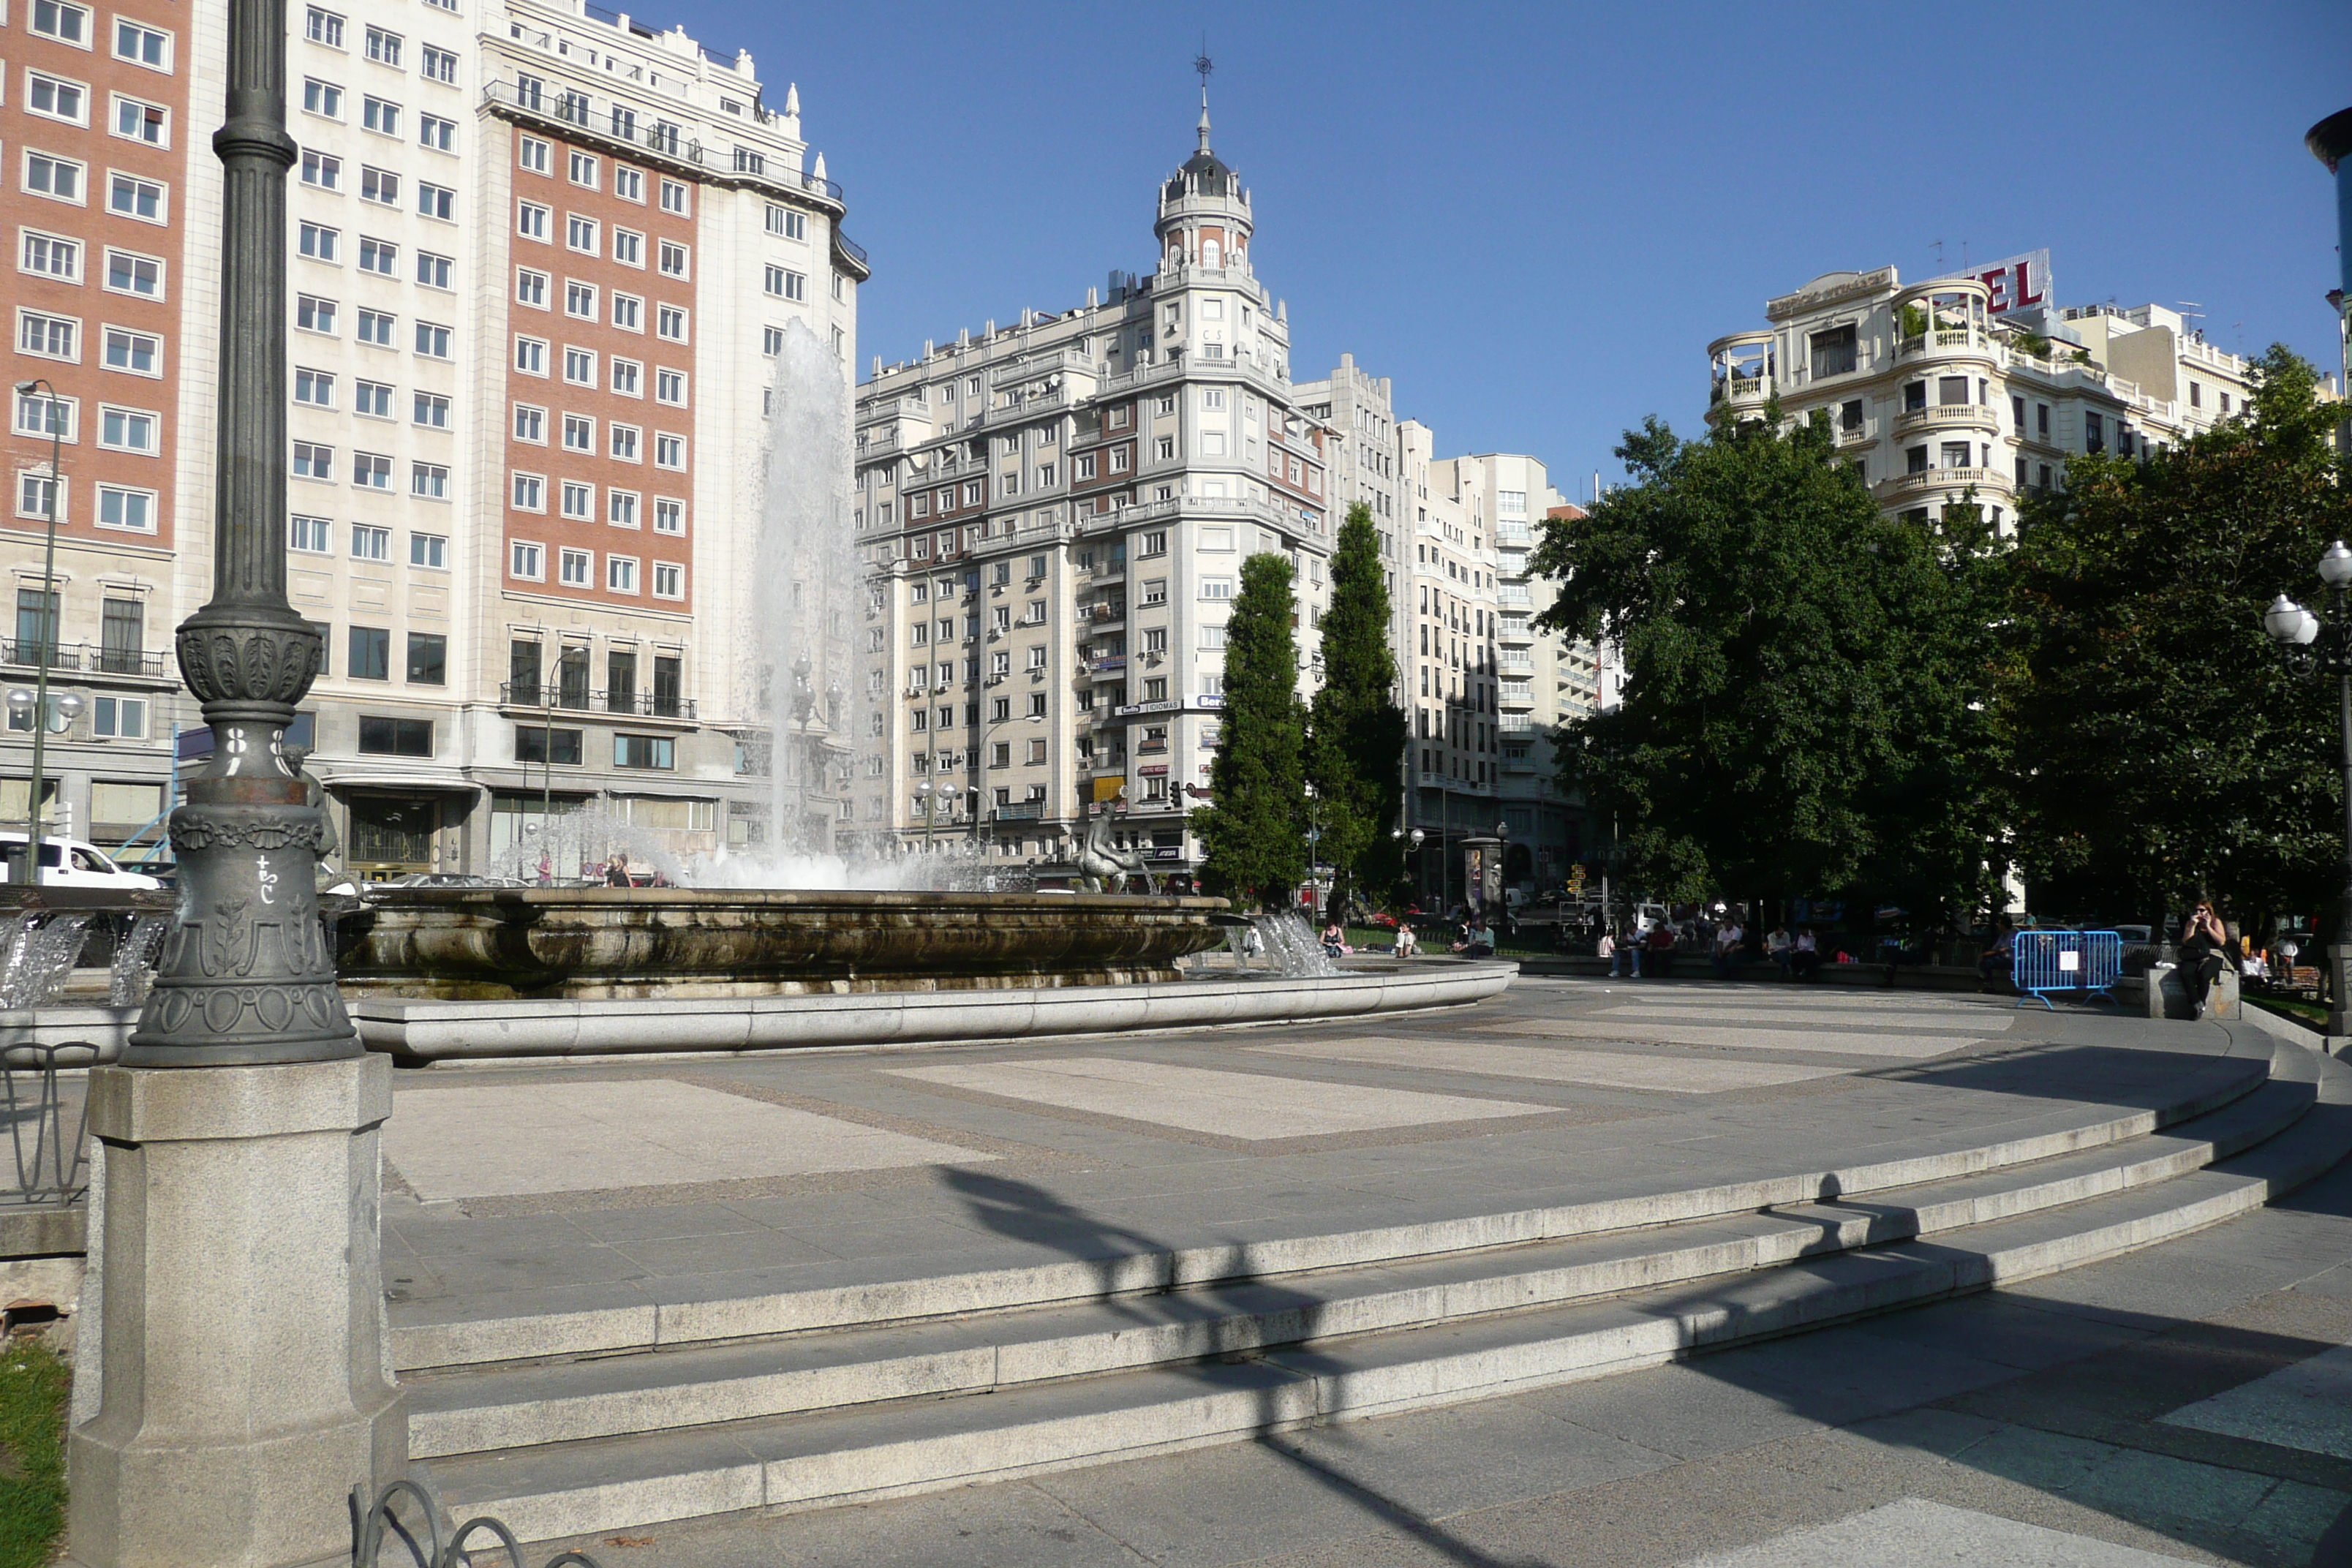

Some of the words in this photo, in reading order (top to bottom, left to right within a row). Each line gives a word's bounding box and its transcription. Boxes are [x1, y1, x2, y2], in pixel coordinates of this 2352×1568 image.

[1090, 655, 1126, 663] LOCUTORIO
[1150, 701, 1177, 711] IDIOMAS
[1201, 696, 1224, 706] Ber
